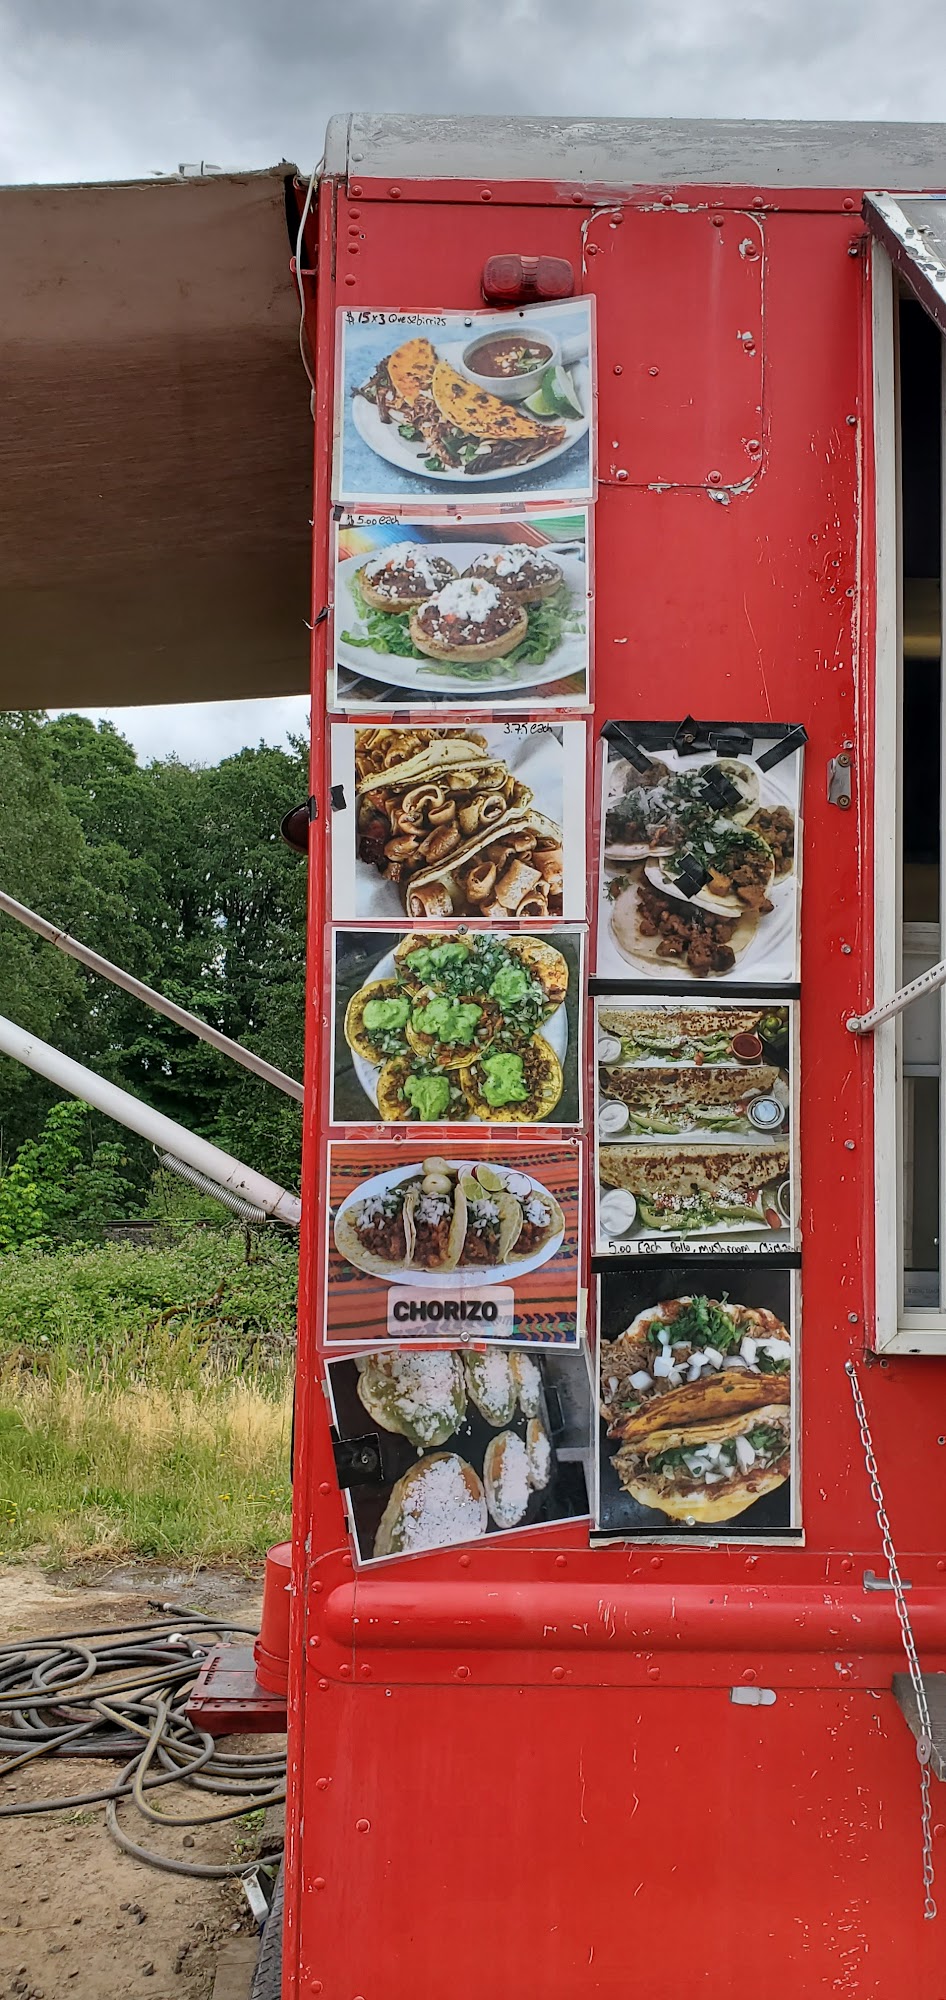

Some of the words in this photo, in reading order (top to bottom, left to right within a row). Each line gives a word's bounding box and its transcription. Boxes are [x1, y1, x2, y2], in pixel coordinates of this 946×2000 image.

[530, 723, 552, 735] each
[608, 1241, 631, 1254] 5.00
[393, 1300, 498, 1322] CHORIZO
